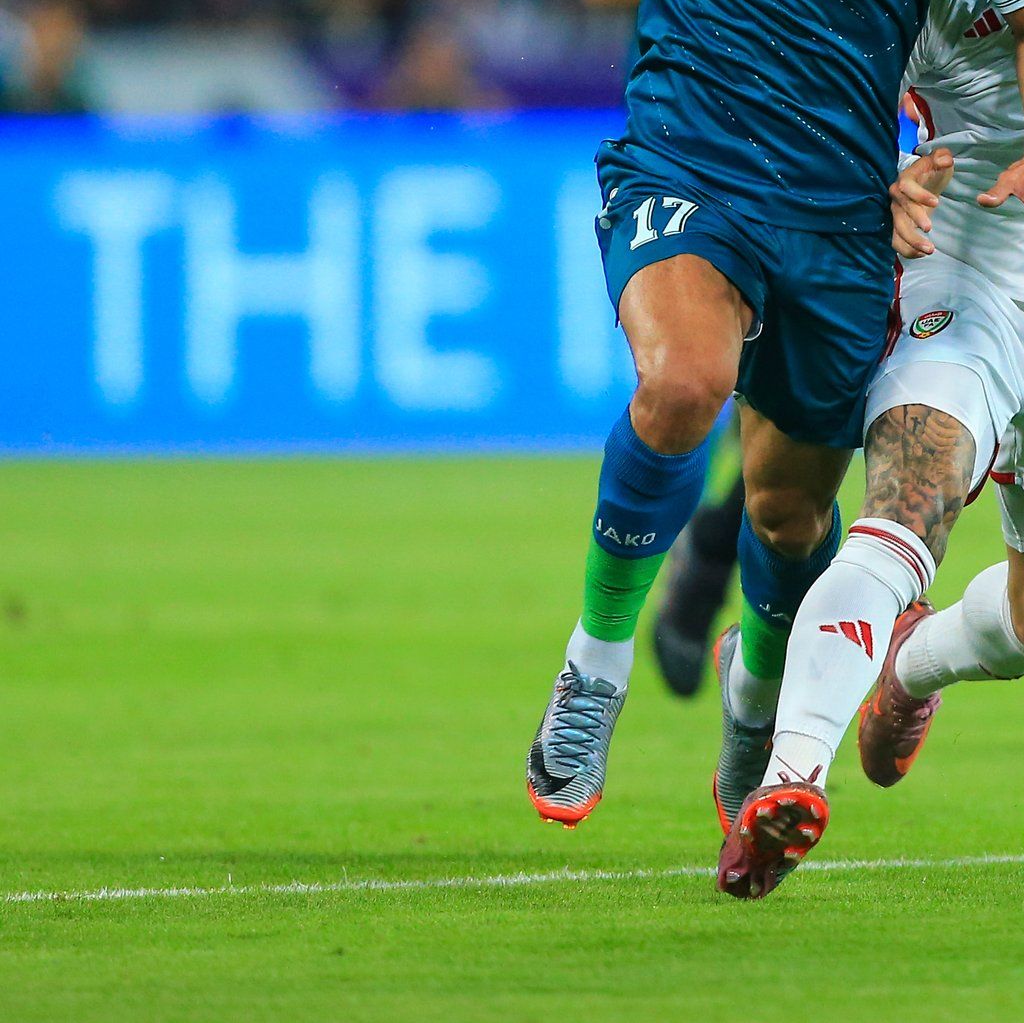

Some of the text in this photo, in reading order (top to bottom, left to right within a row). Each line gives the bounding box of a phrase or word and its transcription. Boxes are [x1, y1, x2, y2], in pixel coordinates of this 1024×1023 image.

[629, 196, 700, 251] 17
[53, 164, 500, 404] THE
[921, 317, 942, 325] UAE
[596, 518, 656, 546] JAKO
